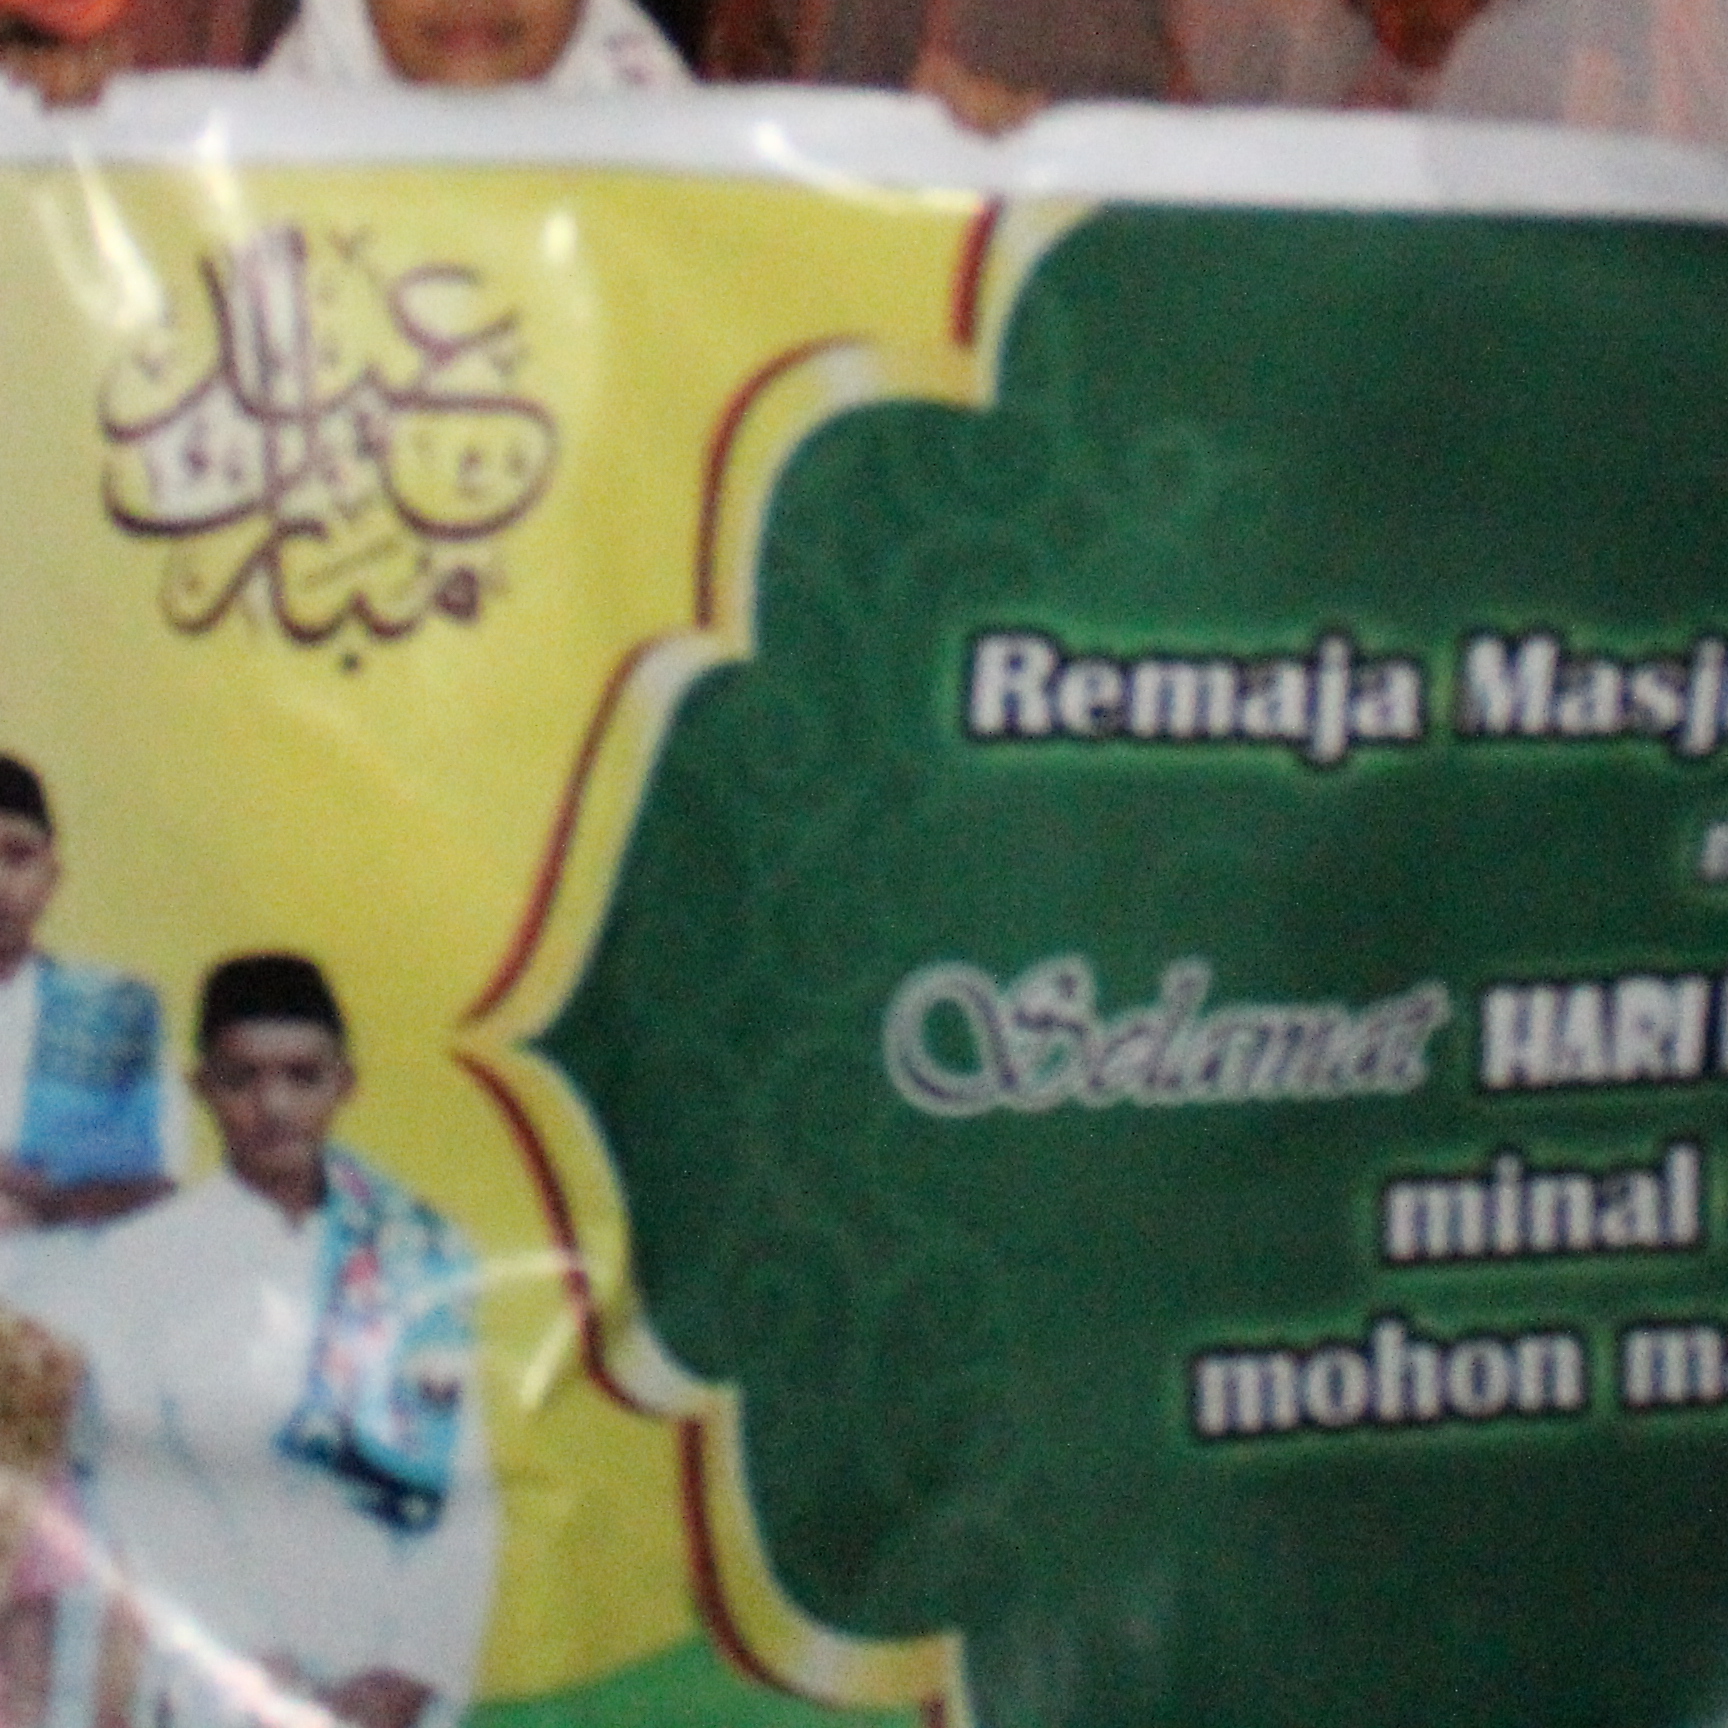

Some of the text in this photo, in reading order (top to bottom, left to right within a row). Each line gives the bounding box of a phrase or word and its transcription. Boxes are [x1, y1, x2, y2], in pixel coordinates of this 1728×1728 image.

[969, 632, 1422, 763] Remaja
[884, 954, 1450, 1117] Selamat
[1482, 974, 1708, 1086] HARI
[1381, 1140, 1702, 1262] minal
[1192, 1314, 1586, 1439] mohon
